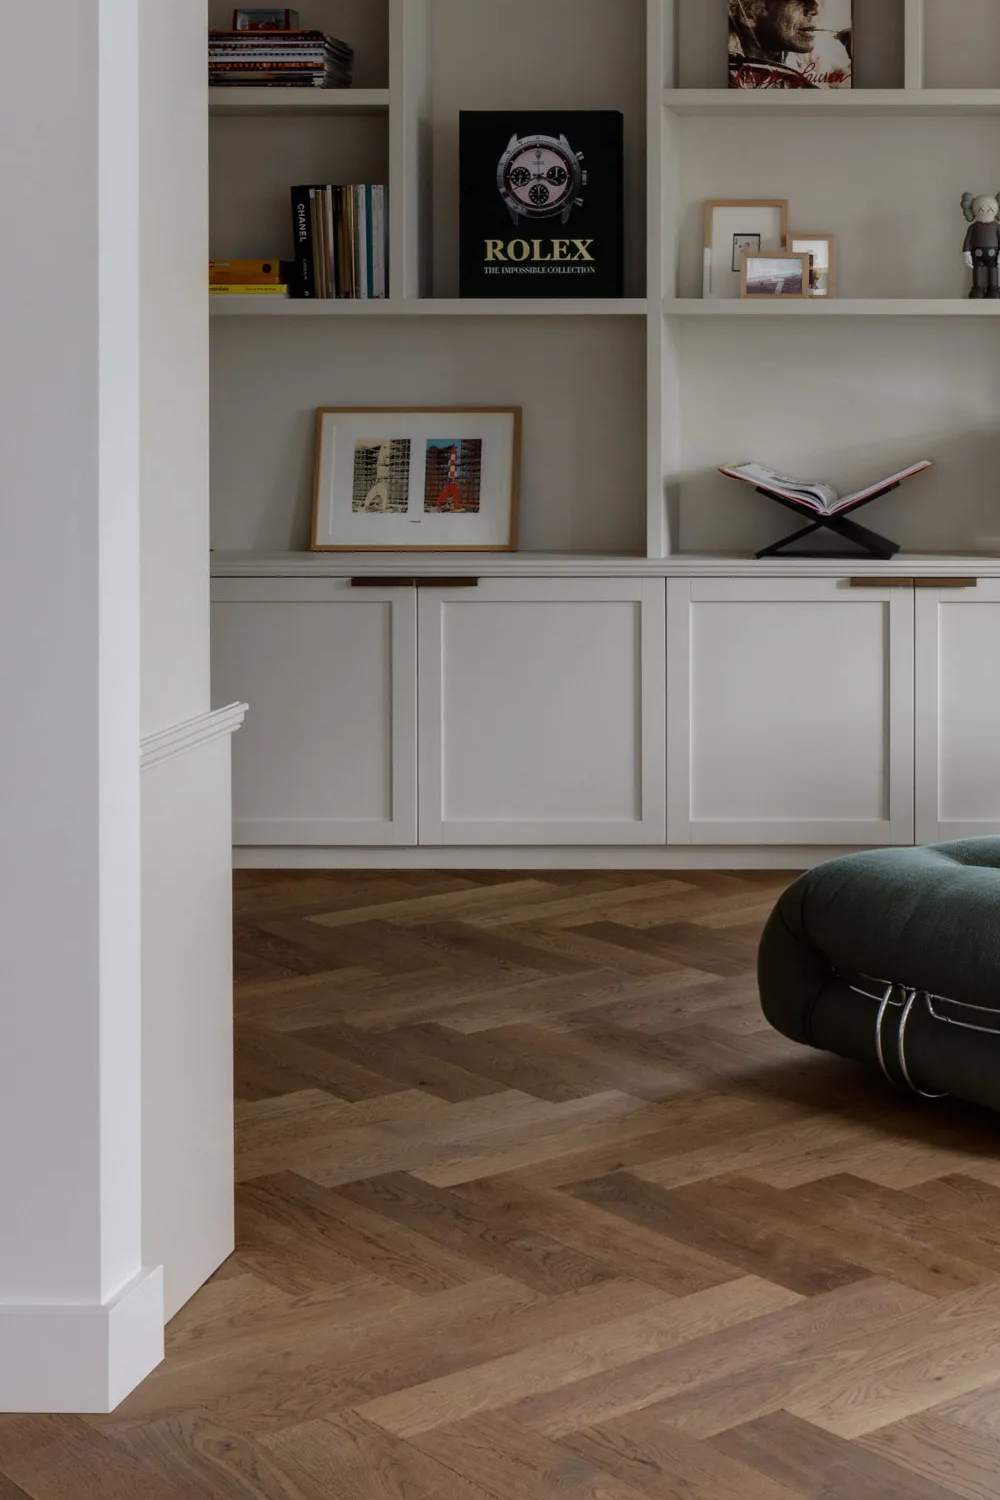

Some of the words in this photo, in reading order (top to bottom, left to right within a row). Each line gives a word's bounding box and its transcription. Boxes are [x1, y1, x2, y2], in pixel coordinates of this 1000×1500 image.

[298, 203, 307, 243] CHANEL
[484, 239, 595, 261] ROLEX
[484, 266, 500, 274] THE
[501, 266, 547, 274] IMPOSSIBLE
[547, 266, 596, 274] COLLECTION
